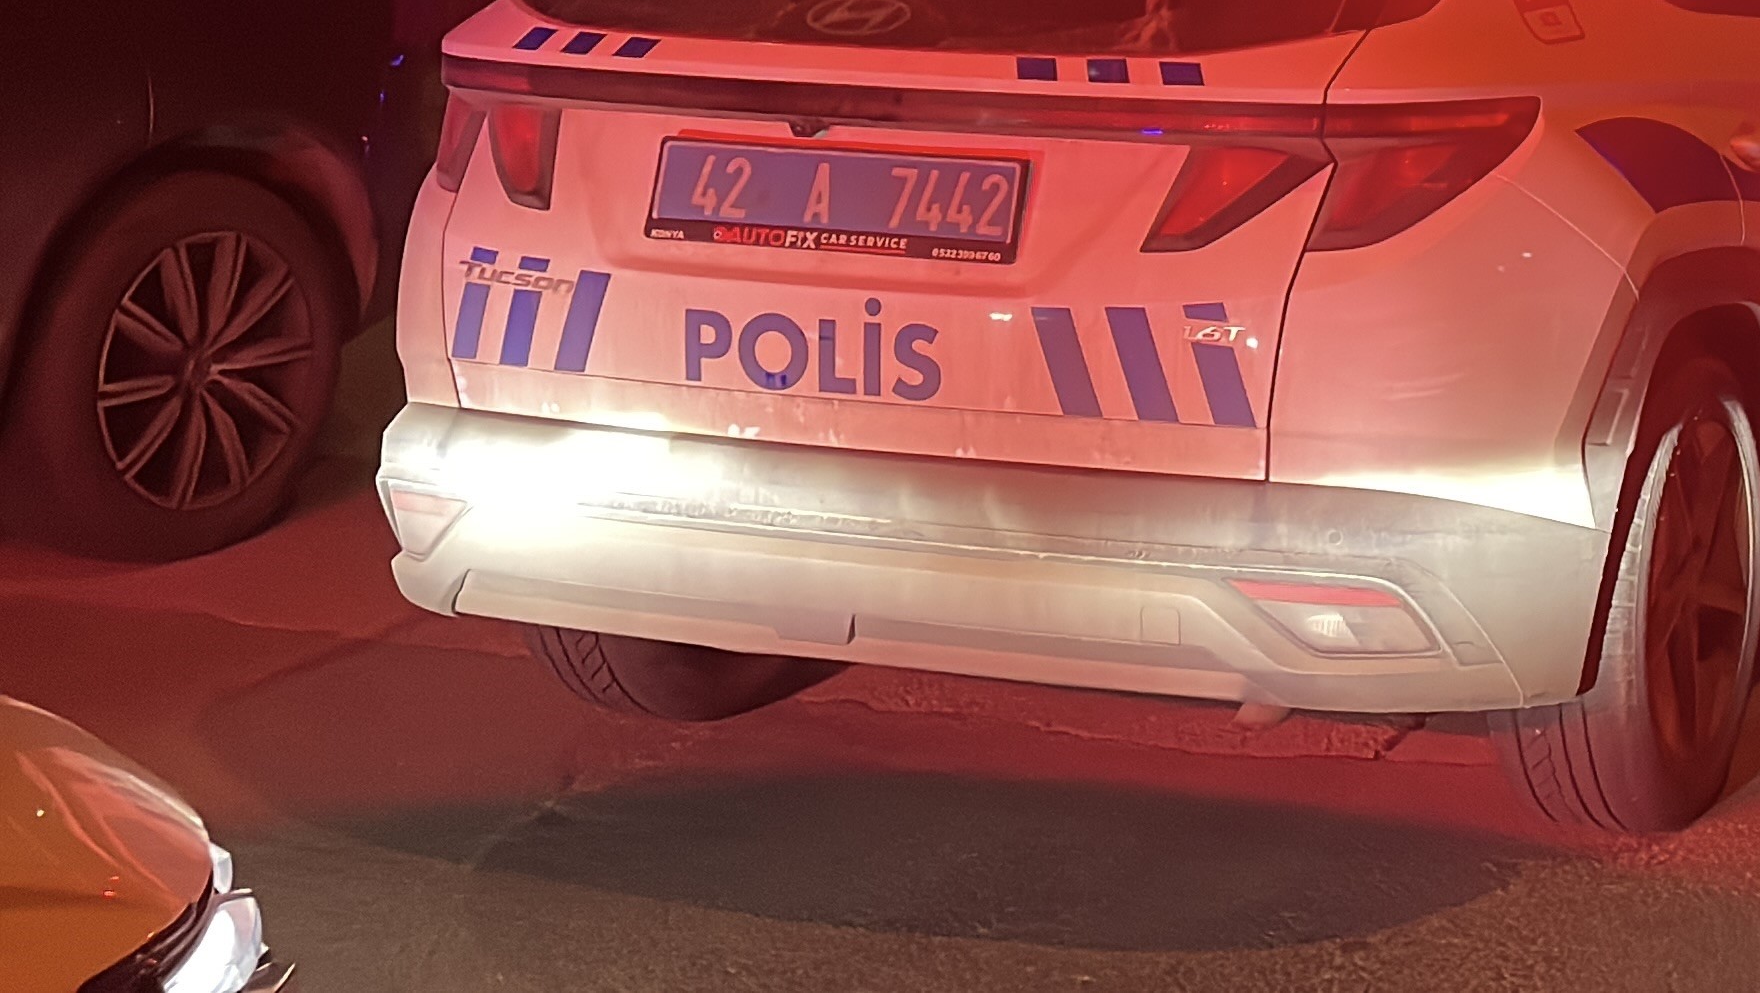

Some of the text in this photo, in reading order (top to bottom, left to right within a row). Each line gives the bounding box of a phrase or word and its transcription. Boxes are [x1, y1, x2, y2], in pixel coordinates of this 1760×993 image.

[690, 154, 1010, 237] 42 A 7442
[820, 232, 848, 245] CAR
[850, 235, 908, 249] SERVICE
[684, 297, 942, 401] POLİS
